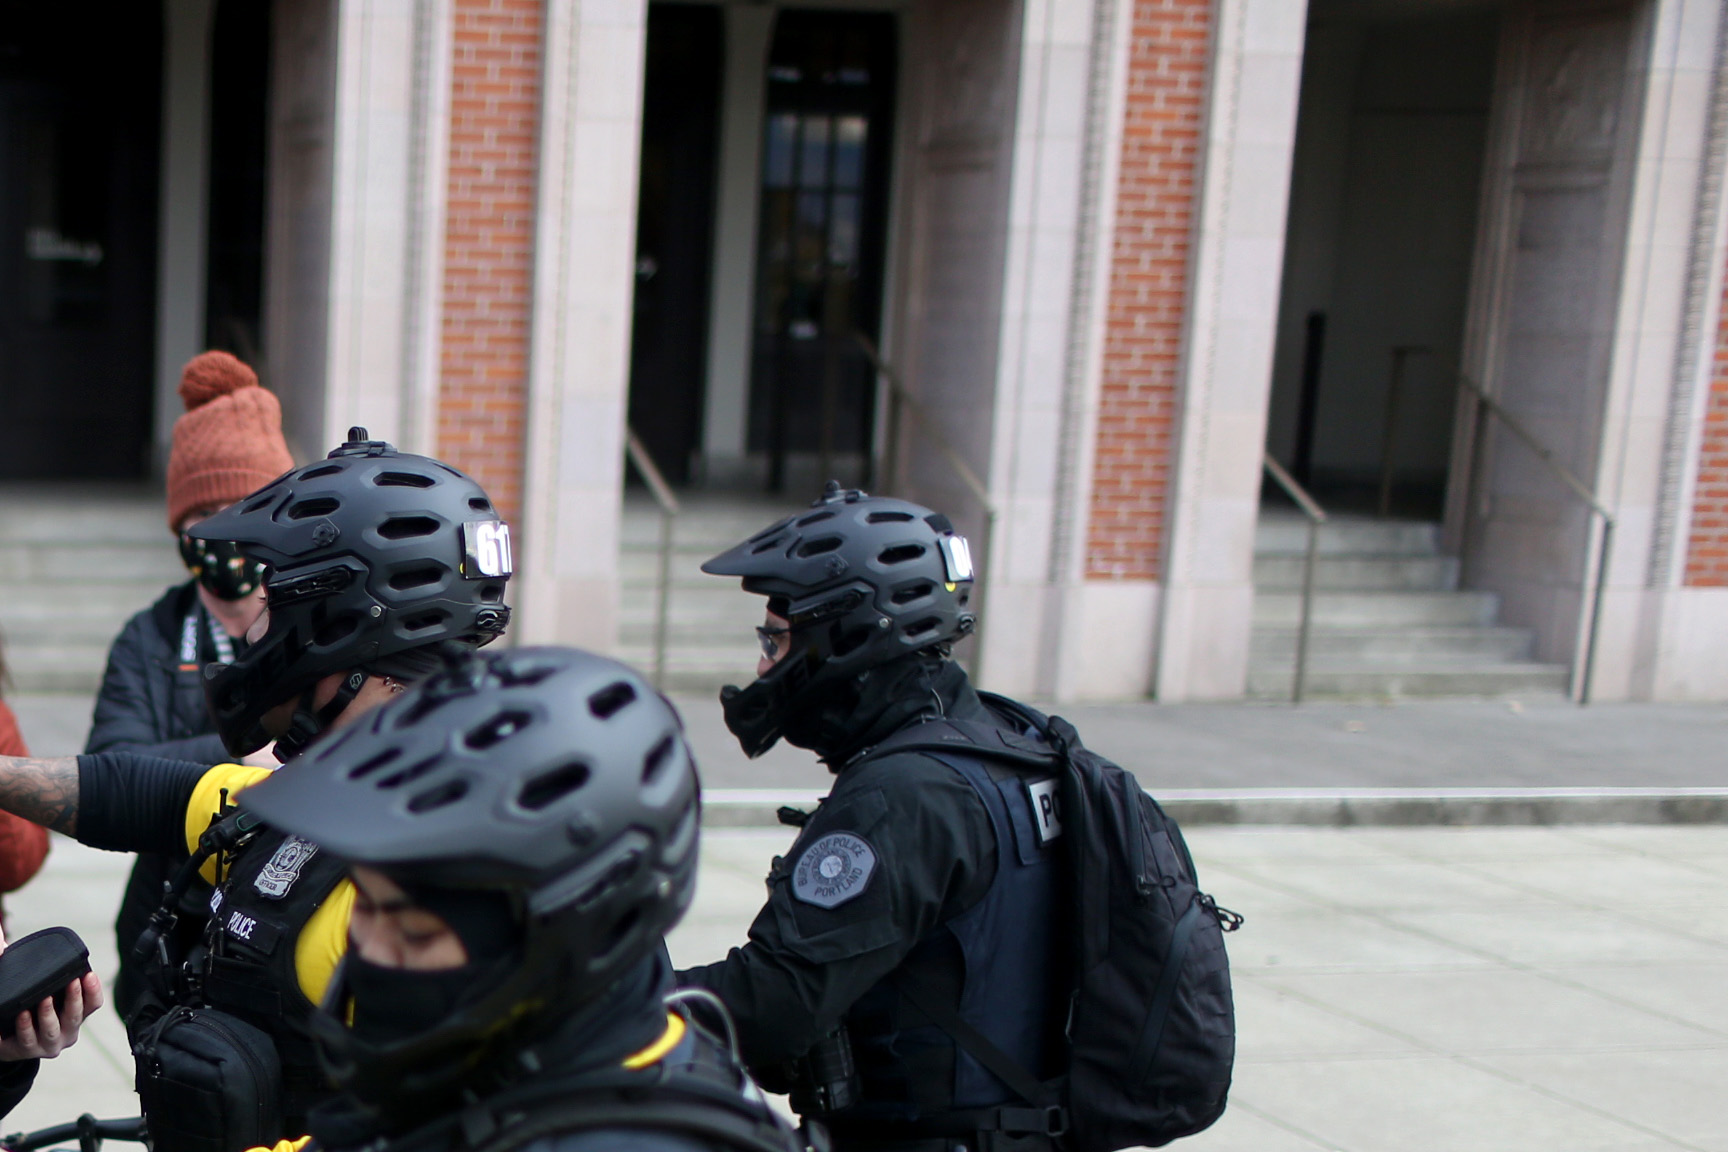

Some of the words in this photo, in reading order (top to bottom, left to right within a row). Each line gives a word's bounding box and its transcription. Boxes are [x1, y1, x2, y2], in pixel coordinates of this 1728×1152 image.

[833, 837, 867, 859] POLICE
[814, 867, 863, 897] PORTLAND
[227, 910, 257, 940] POLICE
